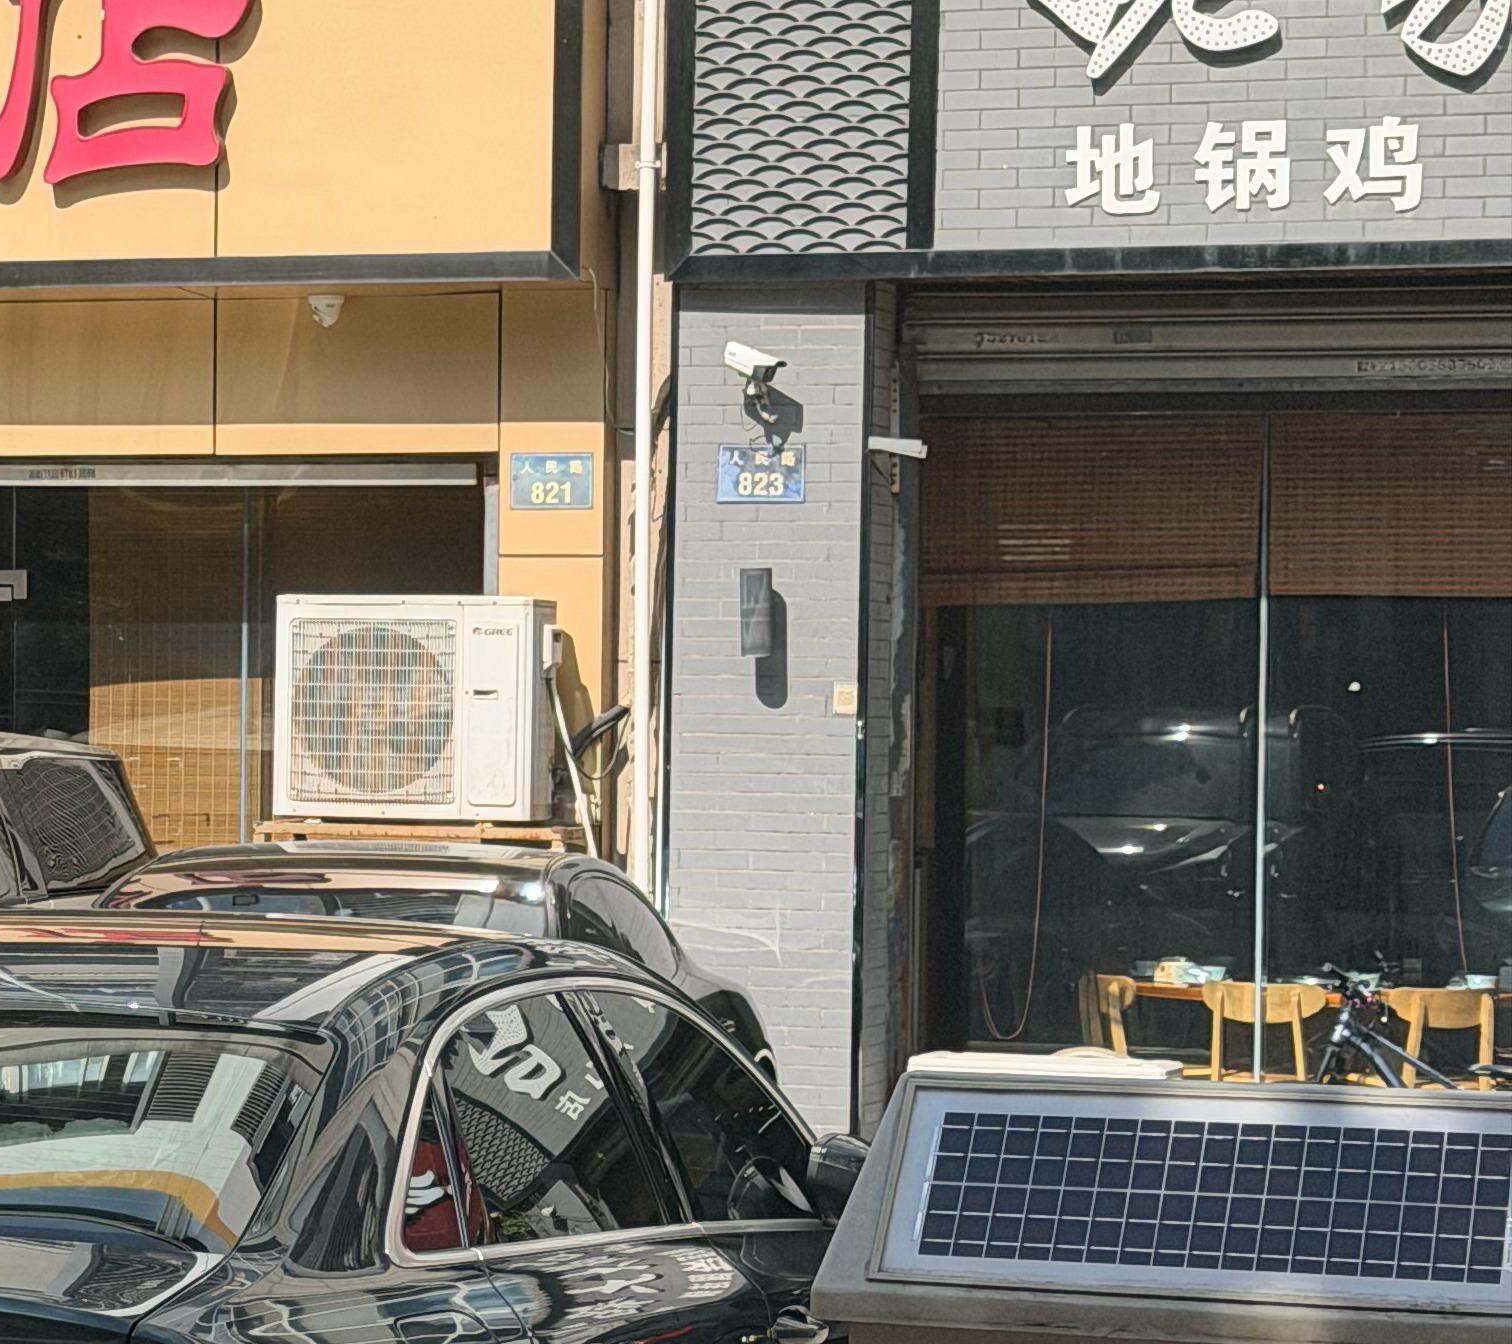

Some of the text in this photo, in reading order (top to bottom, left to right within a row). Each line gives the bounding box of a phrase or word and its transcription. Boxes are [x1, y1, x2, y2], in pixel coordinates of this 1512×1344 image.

[1064, 115, 1424, 215] 地锅鸡
[520, 459, 584, 475] 人民路
[729, 450, 797, 468] 人民路
[530, 481, 572, 505] 821
[738, 471, 784, 497] 823
